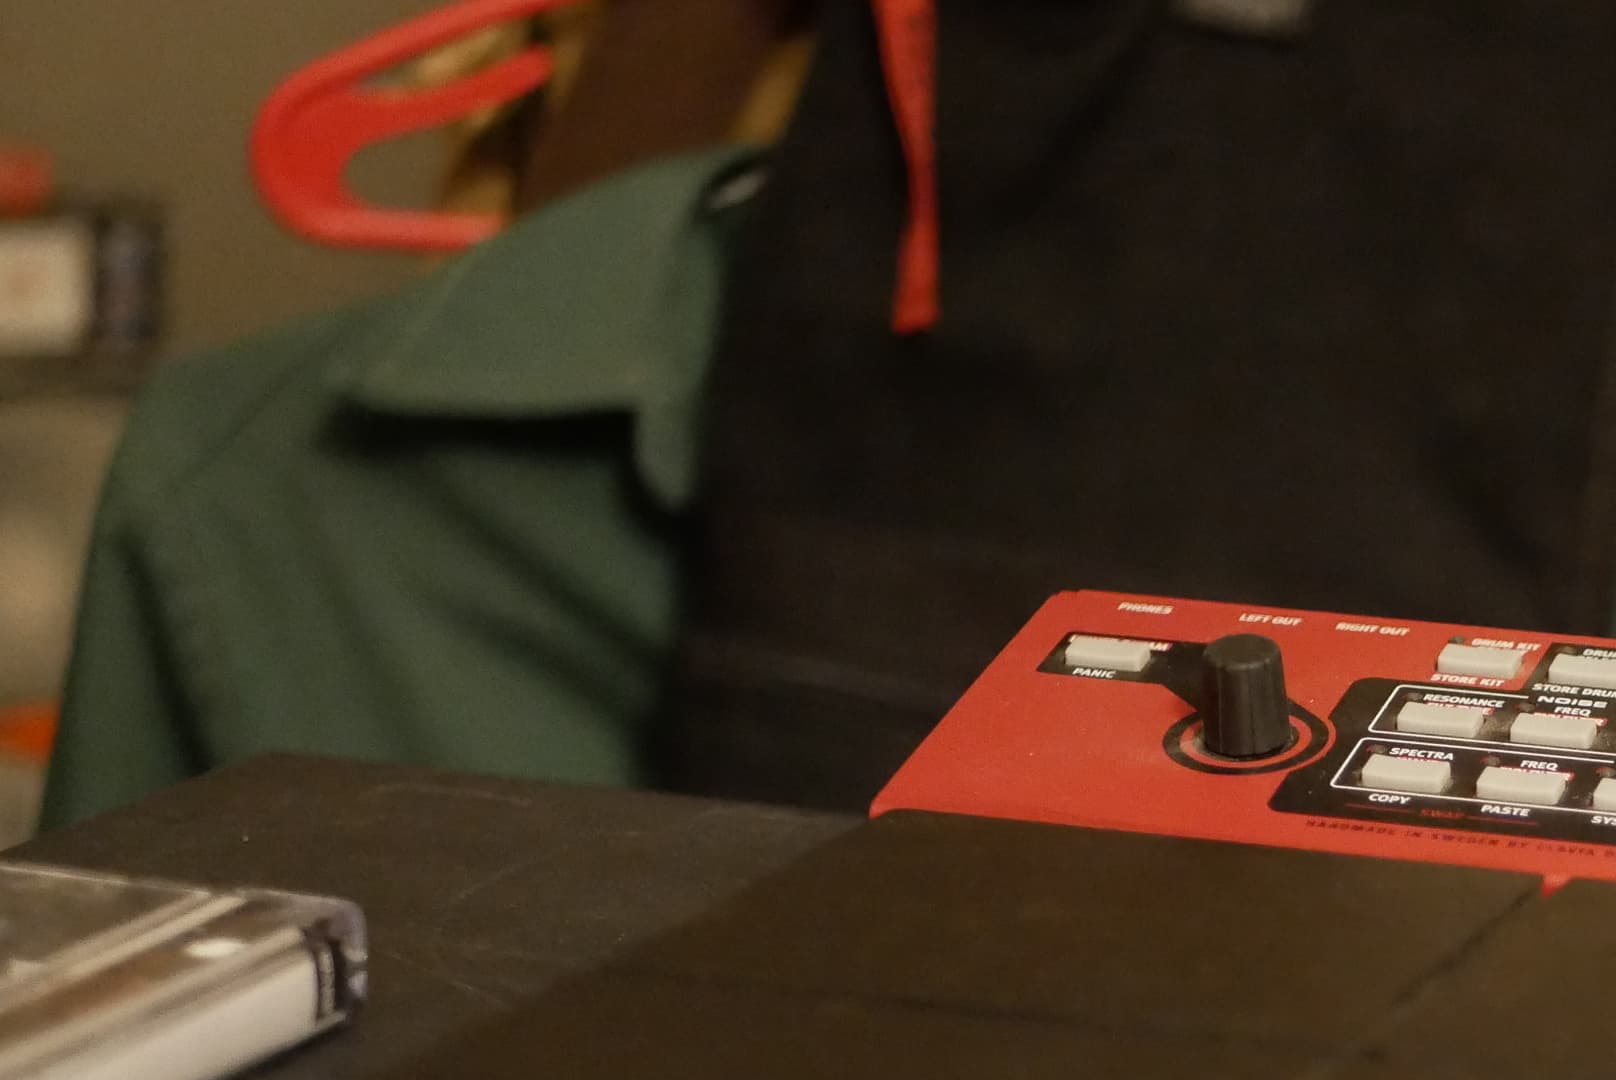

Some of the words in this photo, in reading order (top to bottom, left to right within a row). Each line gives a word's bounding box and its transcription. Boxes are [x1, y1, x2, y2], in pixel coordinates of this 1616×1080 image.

[1118, 602, 1174, 615] PHONES
[1239, 613, 1272, 624] LEFT
[1272, 616, 1302, 626] OUT
[1335, 622, 1380, 633] RIGHT
[1379, 627, 1410, 636] OUT
[1471, 638, 1514, 649] DRUM
[1517, 642, 1542, 651] KIT
[1072, 667, 1117, 679] PANIC
[1431, 673, 1477, 686] STORE
[1480, 678, 1505, 687] KIT
[1532, 683, 1579, 695] STORE
[1423, 693, 1505, 708] RESONANCE
[1537, 696, 1608, 708] NOISE
[1554, 706, 1592, 717] FREQ
[1389, 747, 1454, 760] SPECTRA
[1520, 760, 1558, 771] FREQ
[1368, 793, 1411, 804] COPY
[1481, 804, 1530, 817] PASTE
